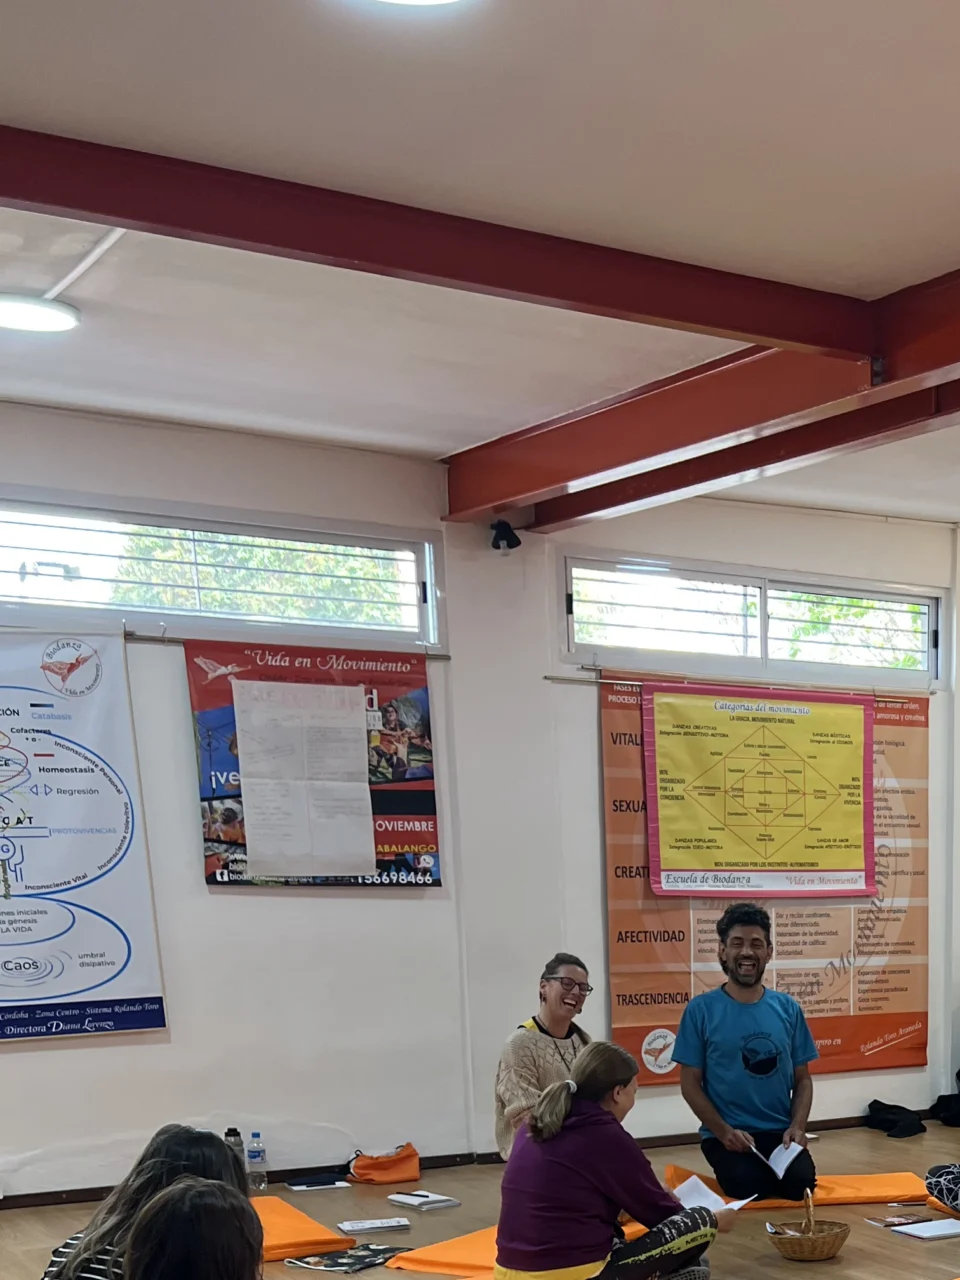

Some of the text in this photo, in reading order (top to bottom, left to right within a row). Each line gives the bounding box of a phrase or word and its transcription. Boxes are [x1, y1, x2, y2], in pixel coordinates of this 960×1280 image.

[295, 657, 311, 667] en
[755, 703, 766, 712] del
[768, 706, 810, 714] movimiento
[31, 712, 72, 720] Catabasis
[38, 765, 95, 774] Homeostasis
[54, 740, 124, 796] Inconsciente Personal
[56, 787, 99, 796] Regresión
[52, 827, 117, 835] PROTOVIVENCIAS
[374, 820, 434, 832] OVIEMBRE
[1, 844, 10, 853] G
[97, 835, 128, 871] Inconsciente
[25, 872, 88, 891] Inconsciente Vital
[665, 872, 751, 884] Escuela de Biodanza
[617, 930, 685, 943] AFECTIVIDAD
[3, 960, 39, 972] Caos
[79, 960, 116, 968] disipativo
[616, 992, 689, 1006] TRASCENDENCIA
[85, 1006, 112, 1015] Sistema
[114, 1004, 142, 1012] Rolando
[5, 1024, 47, 1035] Directora
[48, 1020, 81, 1032] Diana
